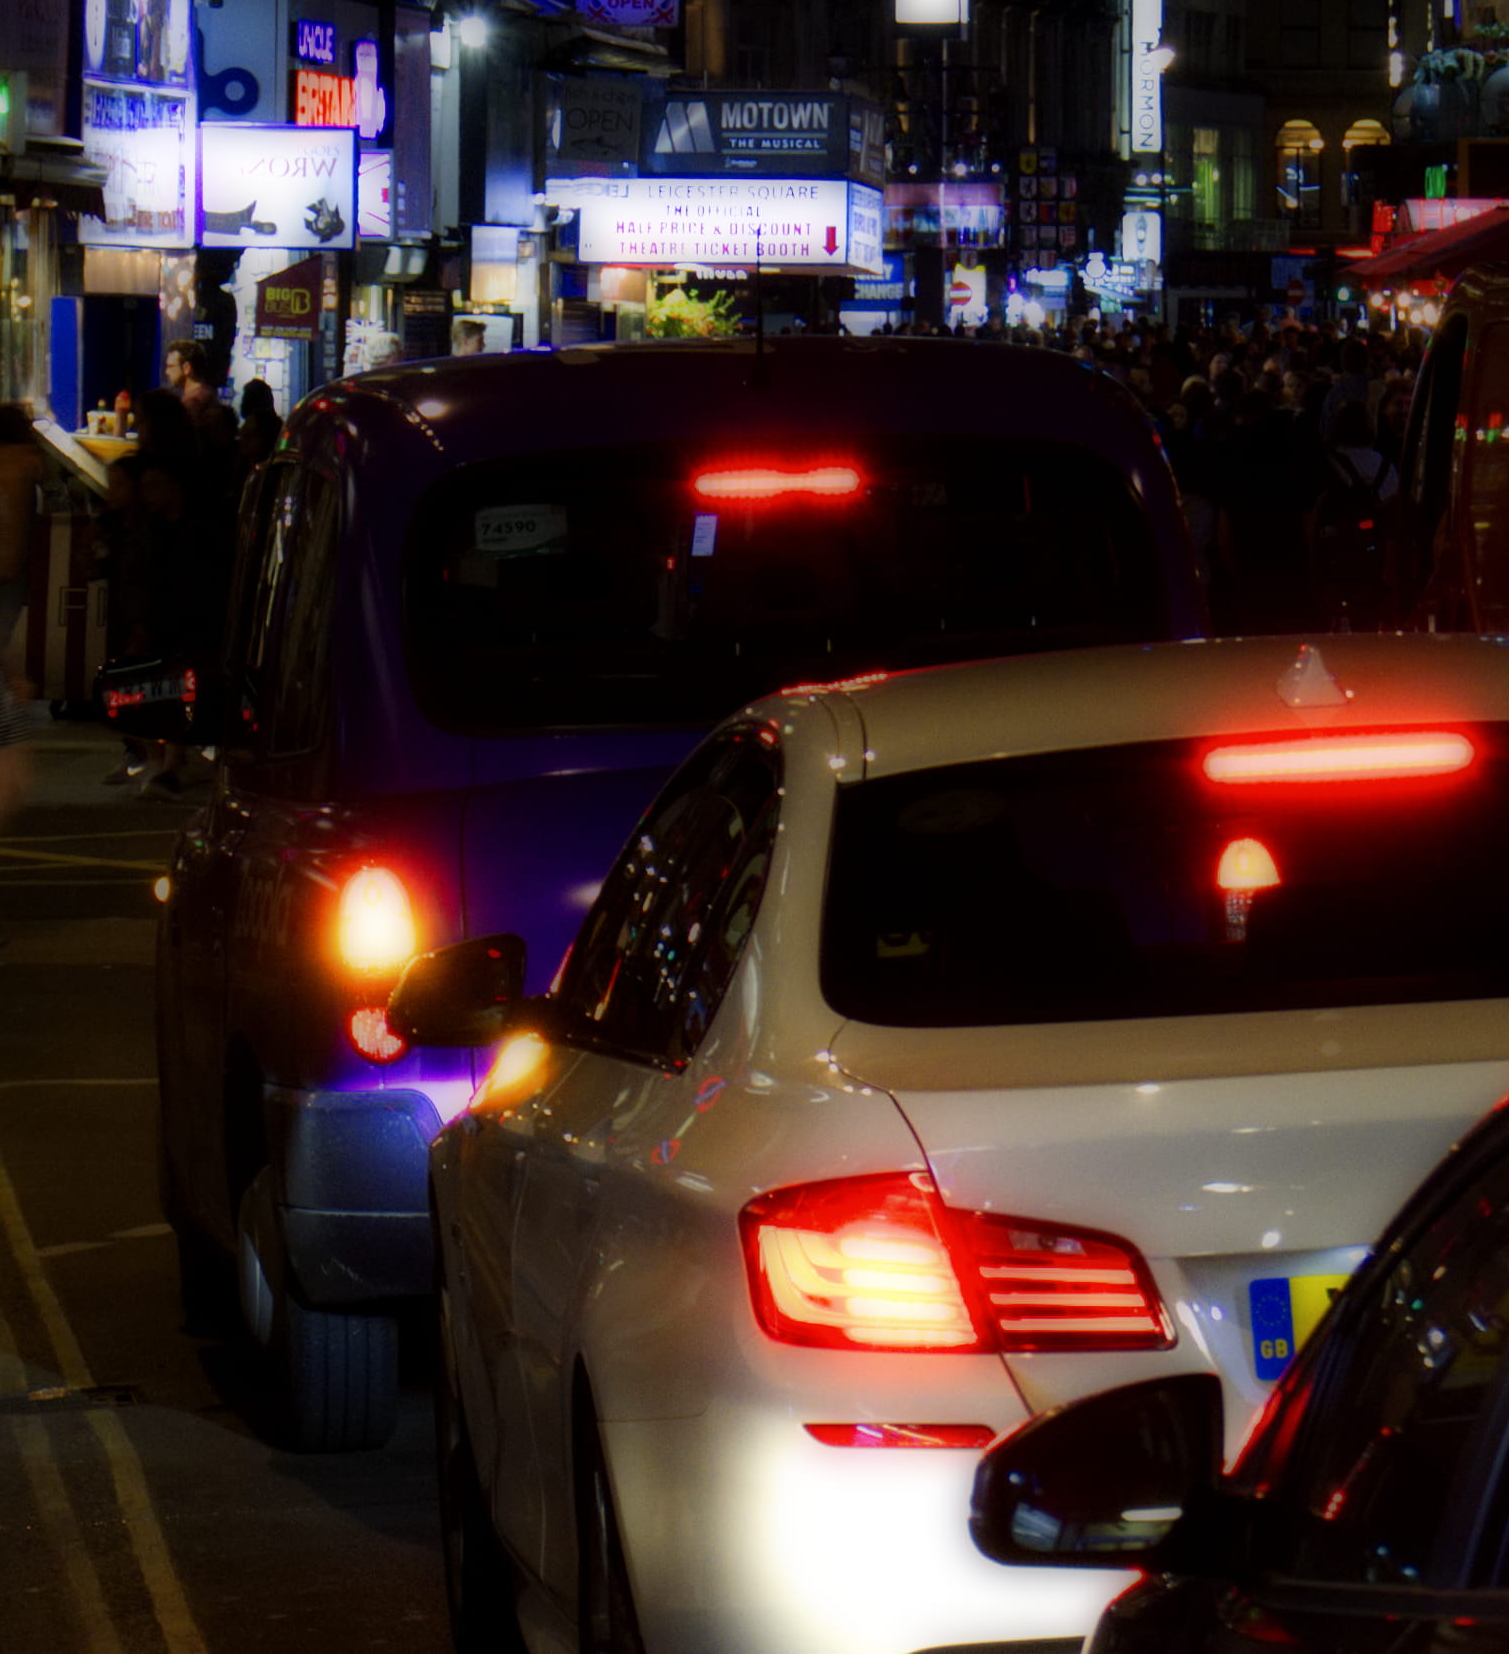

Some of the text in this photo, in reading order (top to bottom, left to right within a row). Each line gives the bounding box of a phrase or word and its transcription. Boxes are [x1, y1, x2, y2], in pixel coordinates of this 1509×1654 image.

[1139, 41, 1155, 148] MORMON
[566, 107, 634, 132] OPEN
[720, 101, 829, 129] MOTOWN
[729, 137, 822, 150] THE MUSICAL
[648, 185, 820, 200] LEICESTER SQUARE
[729, 222, 813, 237] DISCOUNT
[620, 241, 811, 258] THEATRE TICKET BOOTH
[265, 287, 291, 300] BIG
[482, 519, 536, 536] 74590
[1260, 1338, 1289, 1360] GB
